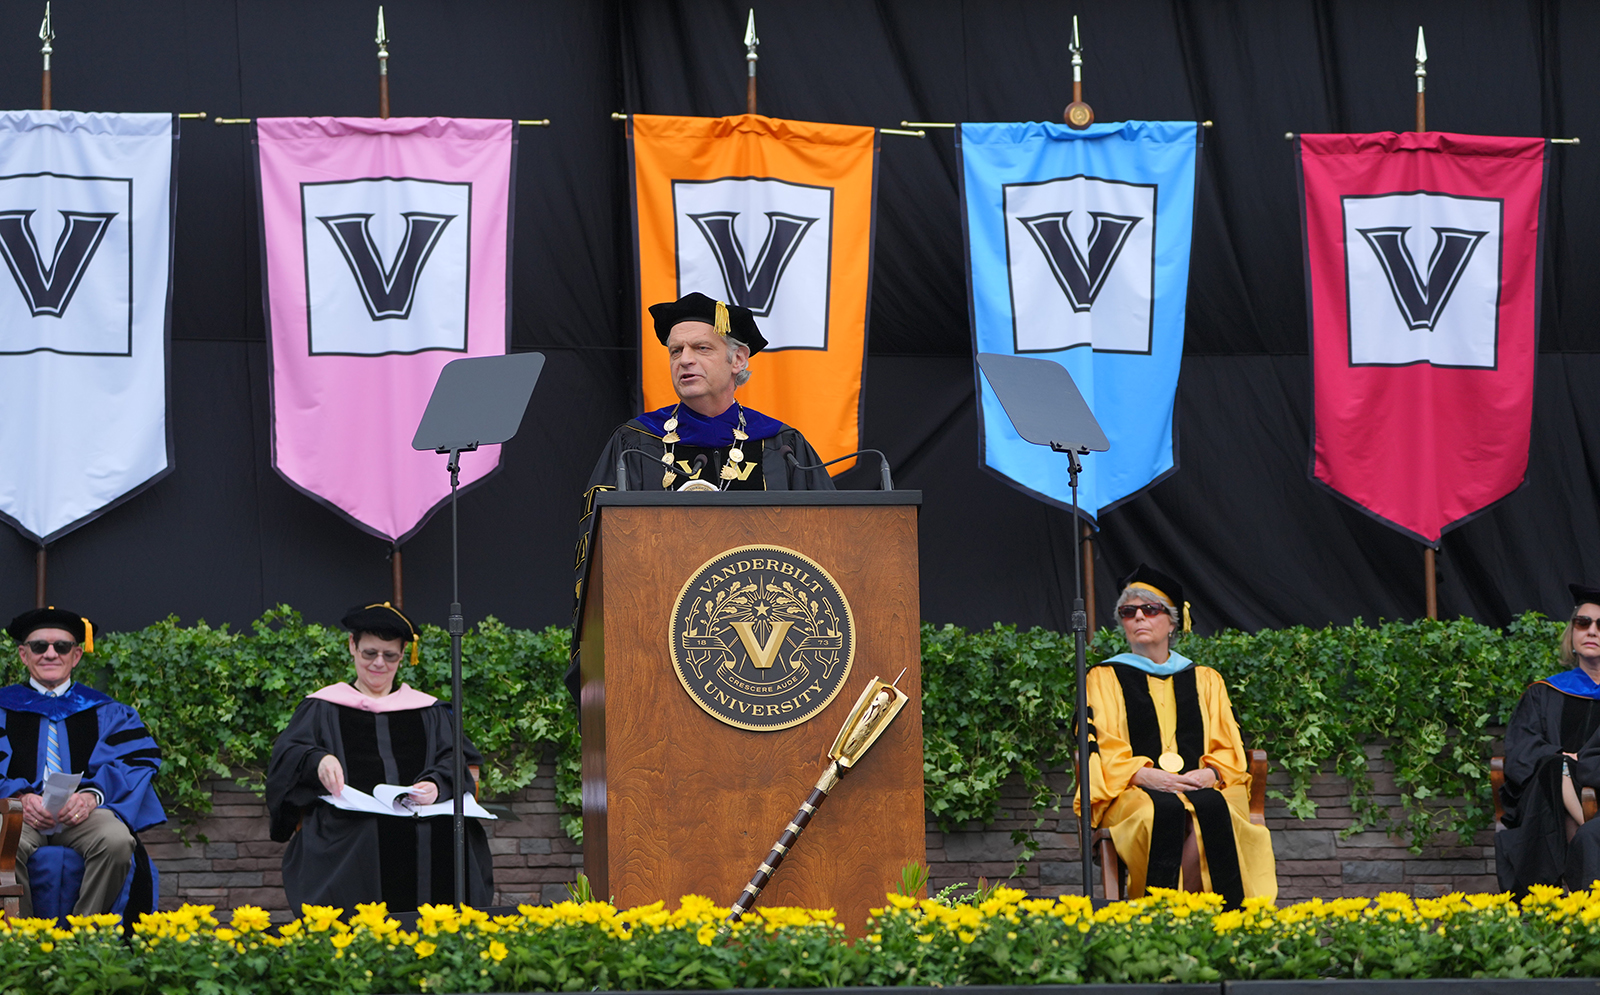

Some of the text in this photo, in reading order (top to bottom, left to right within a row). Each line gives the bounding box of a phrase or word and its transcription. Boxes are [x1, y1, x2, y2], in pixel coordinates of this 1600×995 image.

[0, 209, 119, 319] V
[315, 212, 459, 321] V
[685, 211, 820, 317] V
[1015, 210, 1144, 313] V
[1355, 226, 1490, 332] V
[729, 460, 758, 481] V
[699, 558, 823, 594] VANDERBILT
[729, 621, 795, 669] V
[704, 679, 823, 717] UNIVERSITY
[728, 676, 799, 693] CRESCERE AUDE
